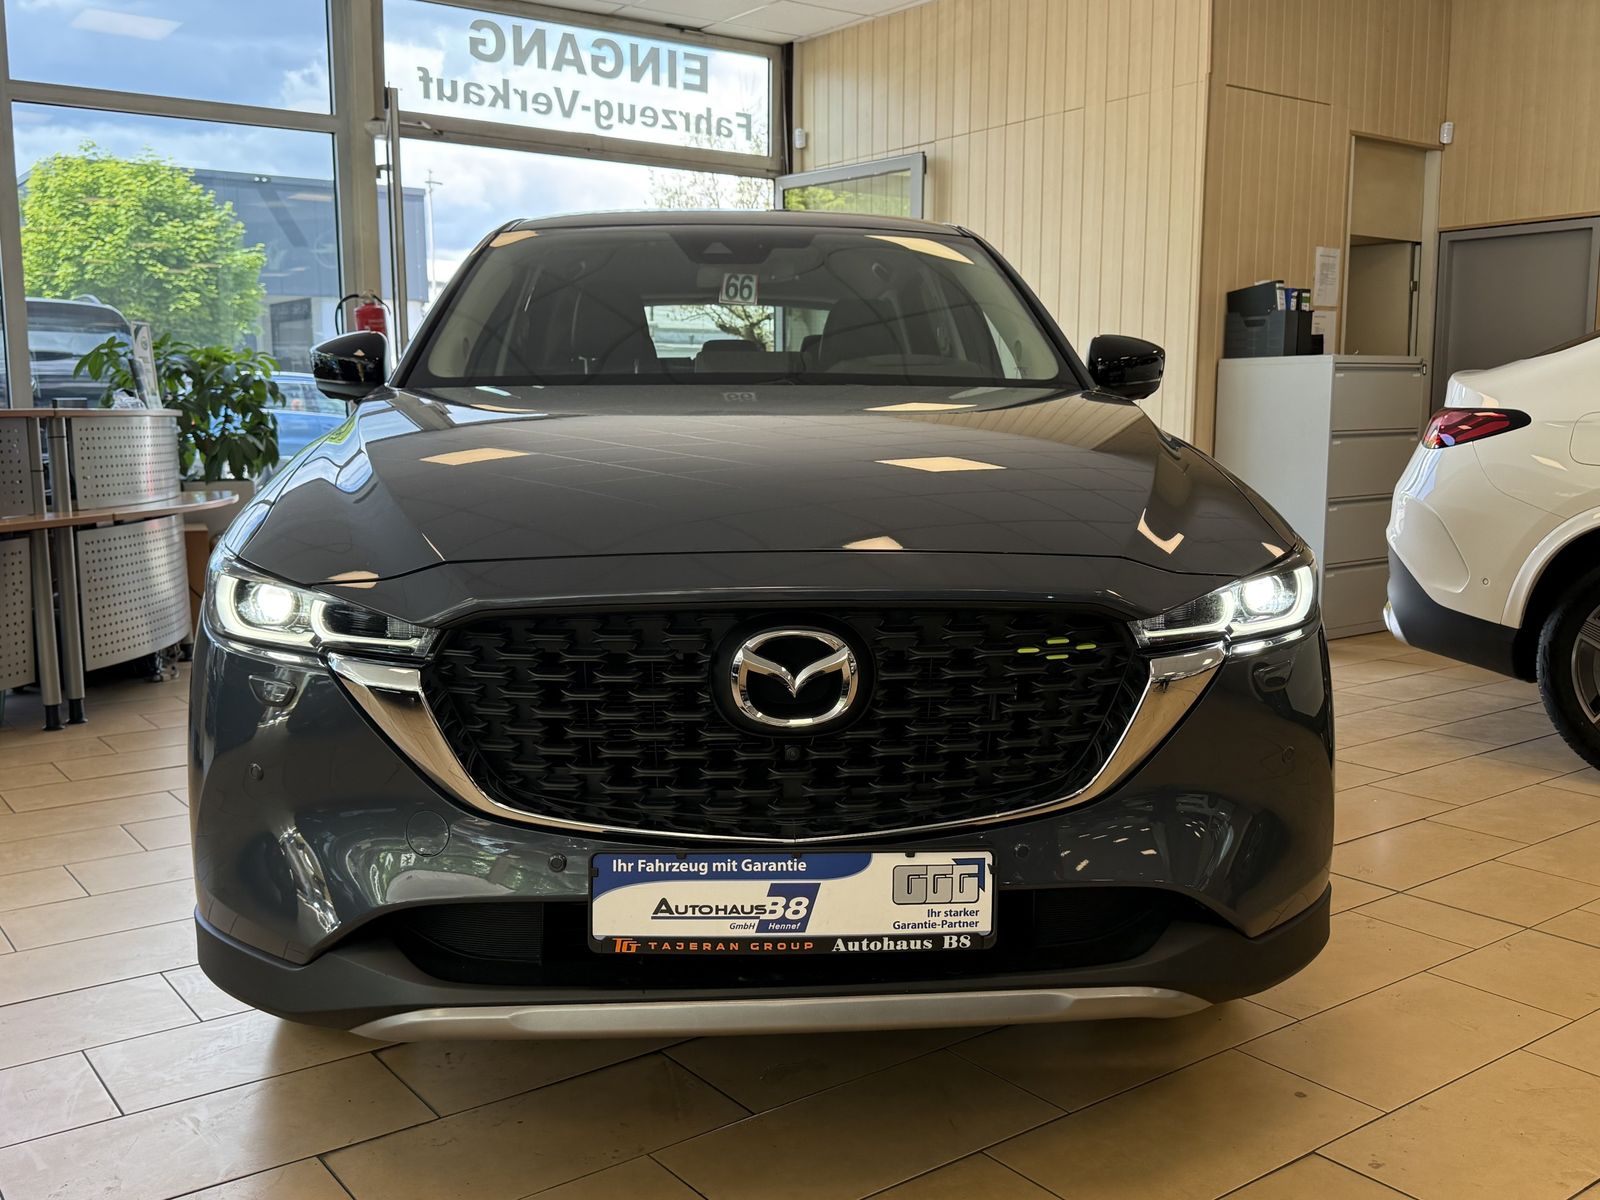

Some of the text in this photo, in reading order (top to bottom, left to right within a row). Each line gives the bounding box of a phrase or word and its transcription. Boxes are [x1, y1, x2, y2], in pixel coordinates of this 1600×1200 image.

[725, 274, 754, 301] 66
[612, 858, 807, 875] Ihr Fahrzeug mit Garantie
[760, 896, 809, 920] B8
[927, 907, 980, 918] Ihr starker
[729, 922, 801, 930] GmbH Hennef
[893, 920, 979, 930] Garantie-Partner
[648, 942, 739, 951] TAJERAN
[750, 942, 814, 950] GROUP
[832, 936, 933, 952] Autohaus
[942, 934, 971, 949] B8
